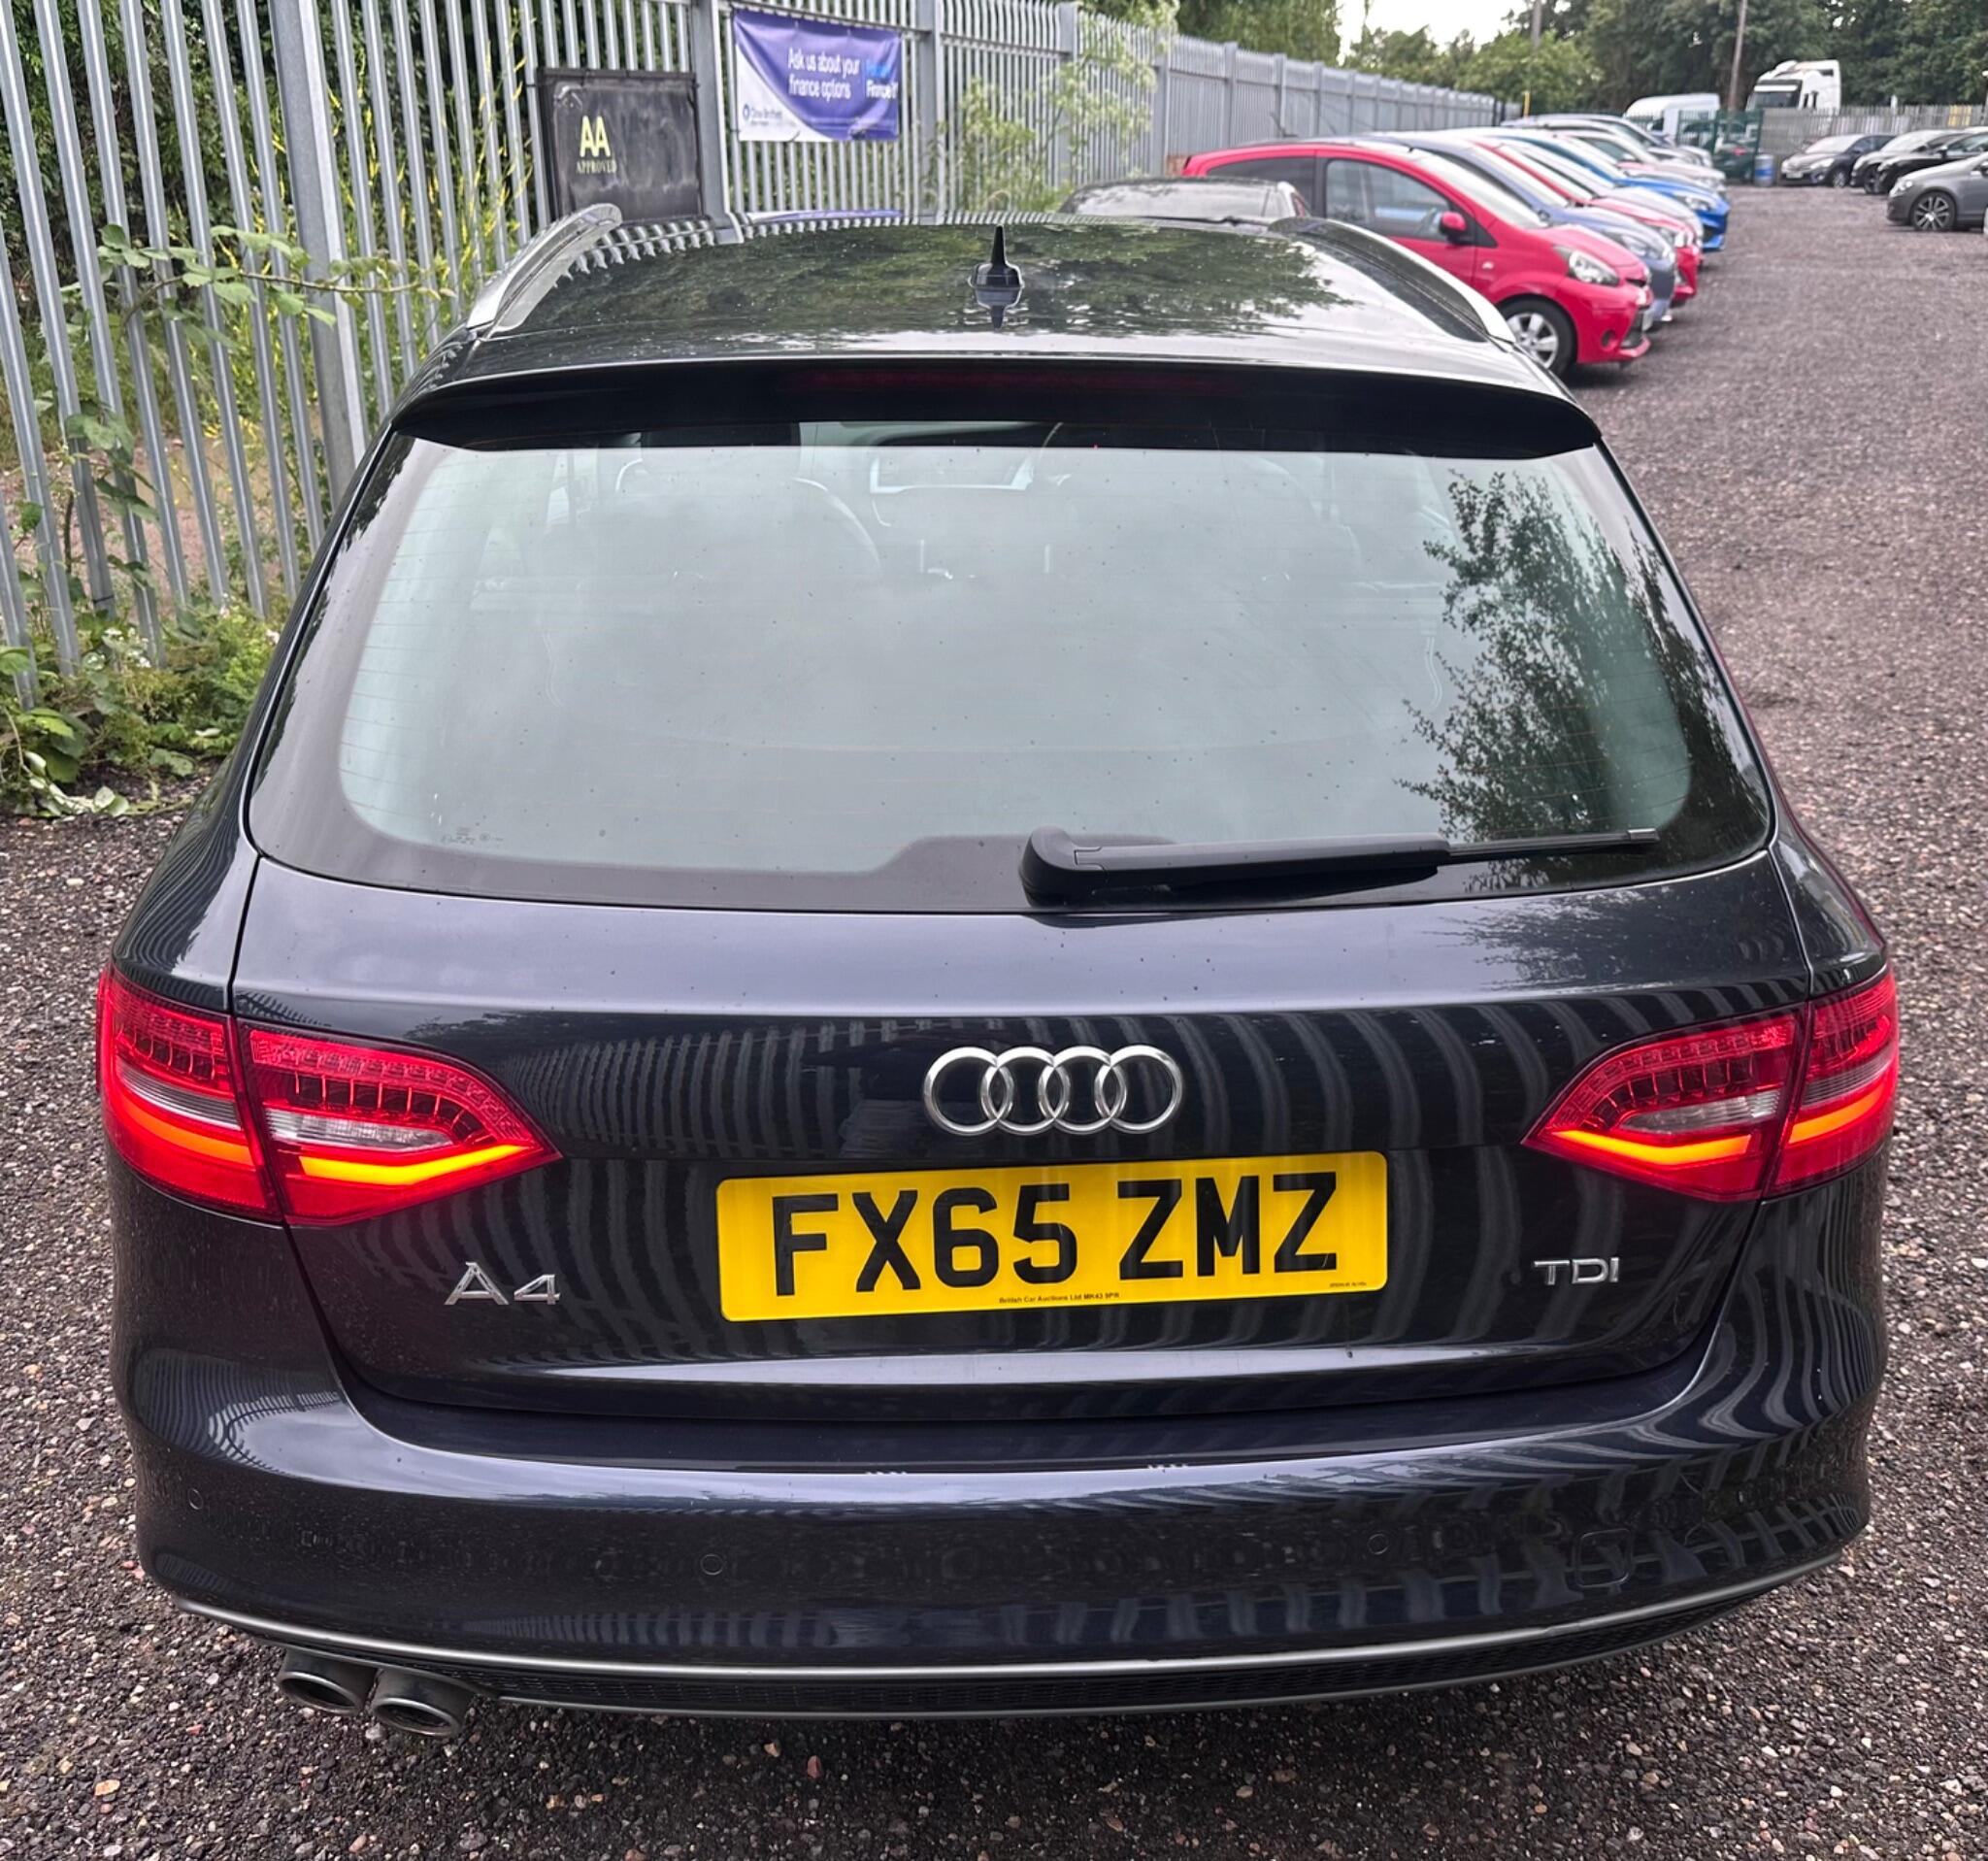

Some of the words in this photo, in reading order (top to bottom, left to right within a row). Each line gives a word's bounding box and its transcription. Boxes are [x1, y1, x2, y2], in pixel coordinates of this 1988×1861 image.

[787, 48, 805, 70] Ask
[806, 53, 816, 71] us
[817, 51, 841, 74] about
[842, 56, 860, 79] your
[788, 74, 819, 97] finance
[821, 79, 851, 103] options
[580, 116, 611, 157] AA
[577, 159, 617, 174] APPROVED
[772, 1183, 1078, 1297] FX65
[1117, 1171, 1338, 1280] ZMZ
[444, 1261, 561, 1306] A4
[1534, 1257, 1619, 1285] TDI
